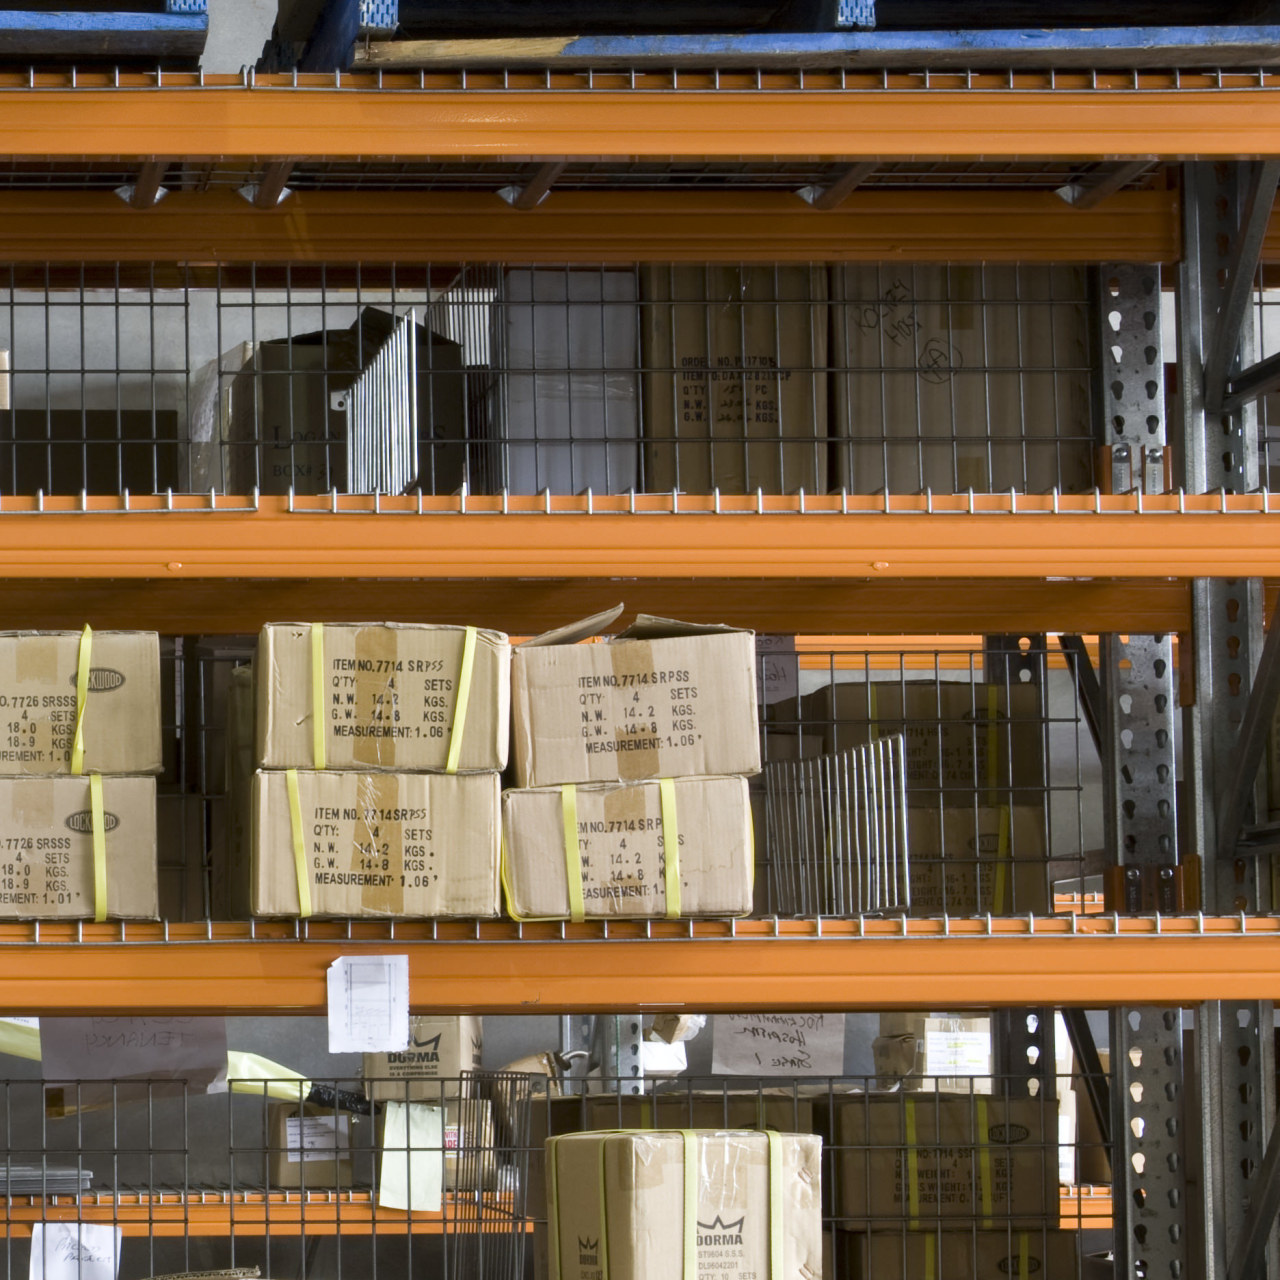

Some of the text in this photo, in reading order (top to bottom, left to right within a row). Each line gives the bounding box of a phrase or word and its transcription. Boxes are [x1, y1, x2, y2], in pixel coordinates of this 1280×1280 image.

[579, 677, 601, 688] ITEM
[670, 687, 698, 700] SETS
[6, 838, 33, 850] 7726
[37, 838, 71, 849] SRSSS
[16, 852, 22, 862] 4
[45, 853, 69, 864] SETS
[46, 867, 69, 877] KGS.
[696, 1235, 743, 1246] DORMA
